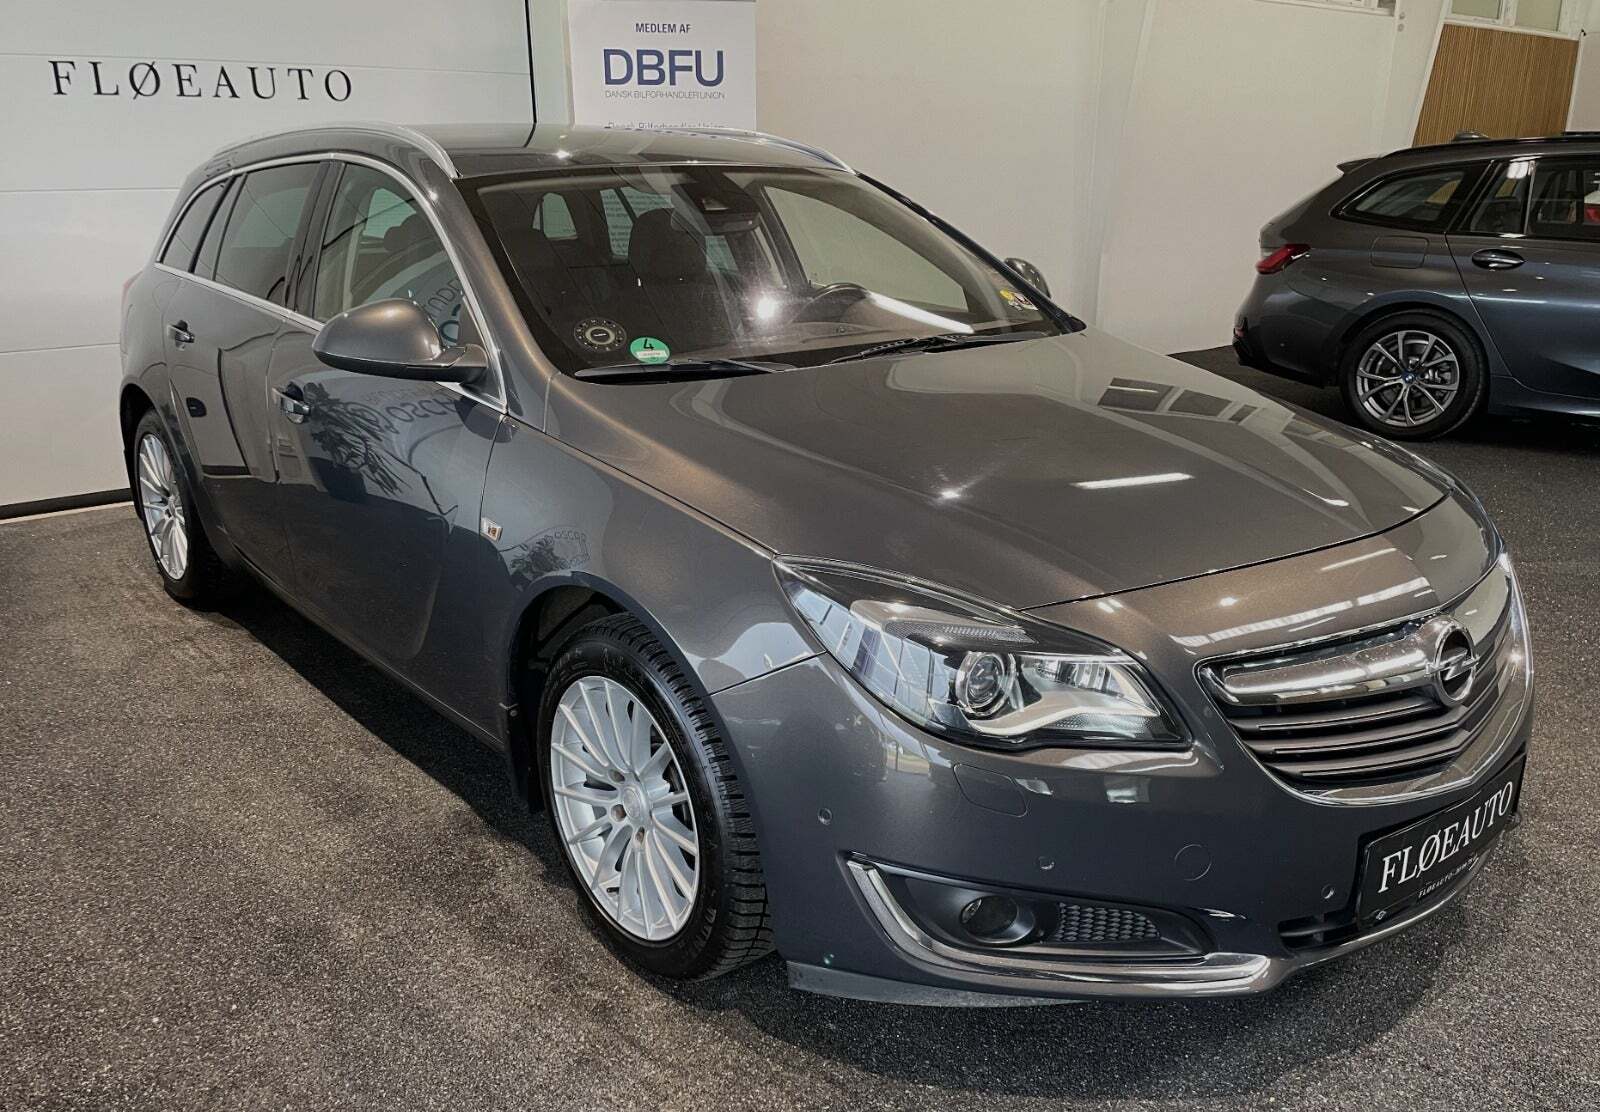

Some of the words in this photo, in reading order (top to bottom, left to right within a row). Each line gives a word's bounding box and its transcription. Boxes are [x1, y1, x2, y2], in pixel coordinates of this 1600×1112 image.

[635, 23, 677, 34] MEDLEM
[679, 24, 691, 34] AF
[48, 60, 352, 101] FLØEAUTO
[604, 49, 723, 87] DBFU
[1378, 781, 1513, 894] FLØEAUTO
